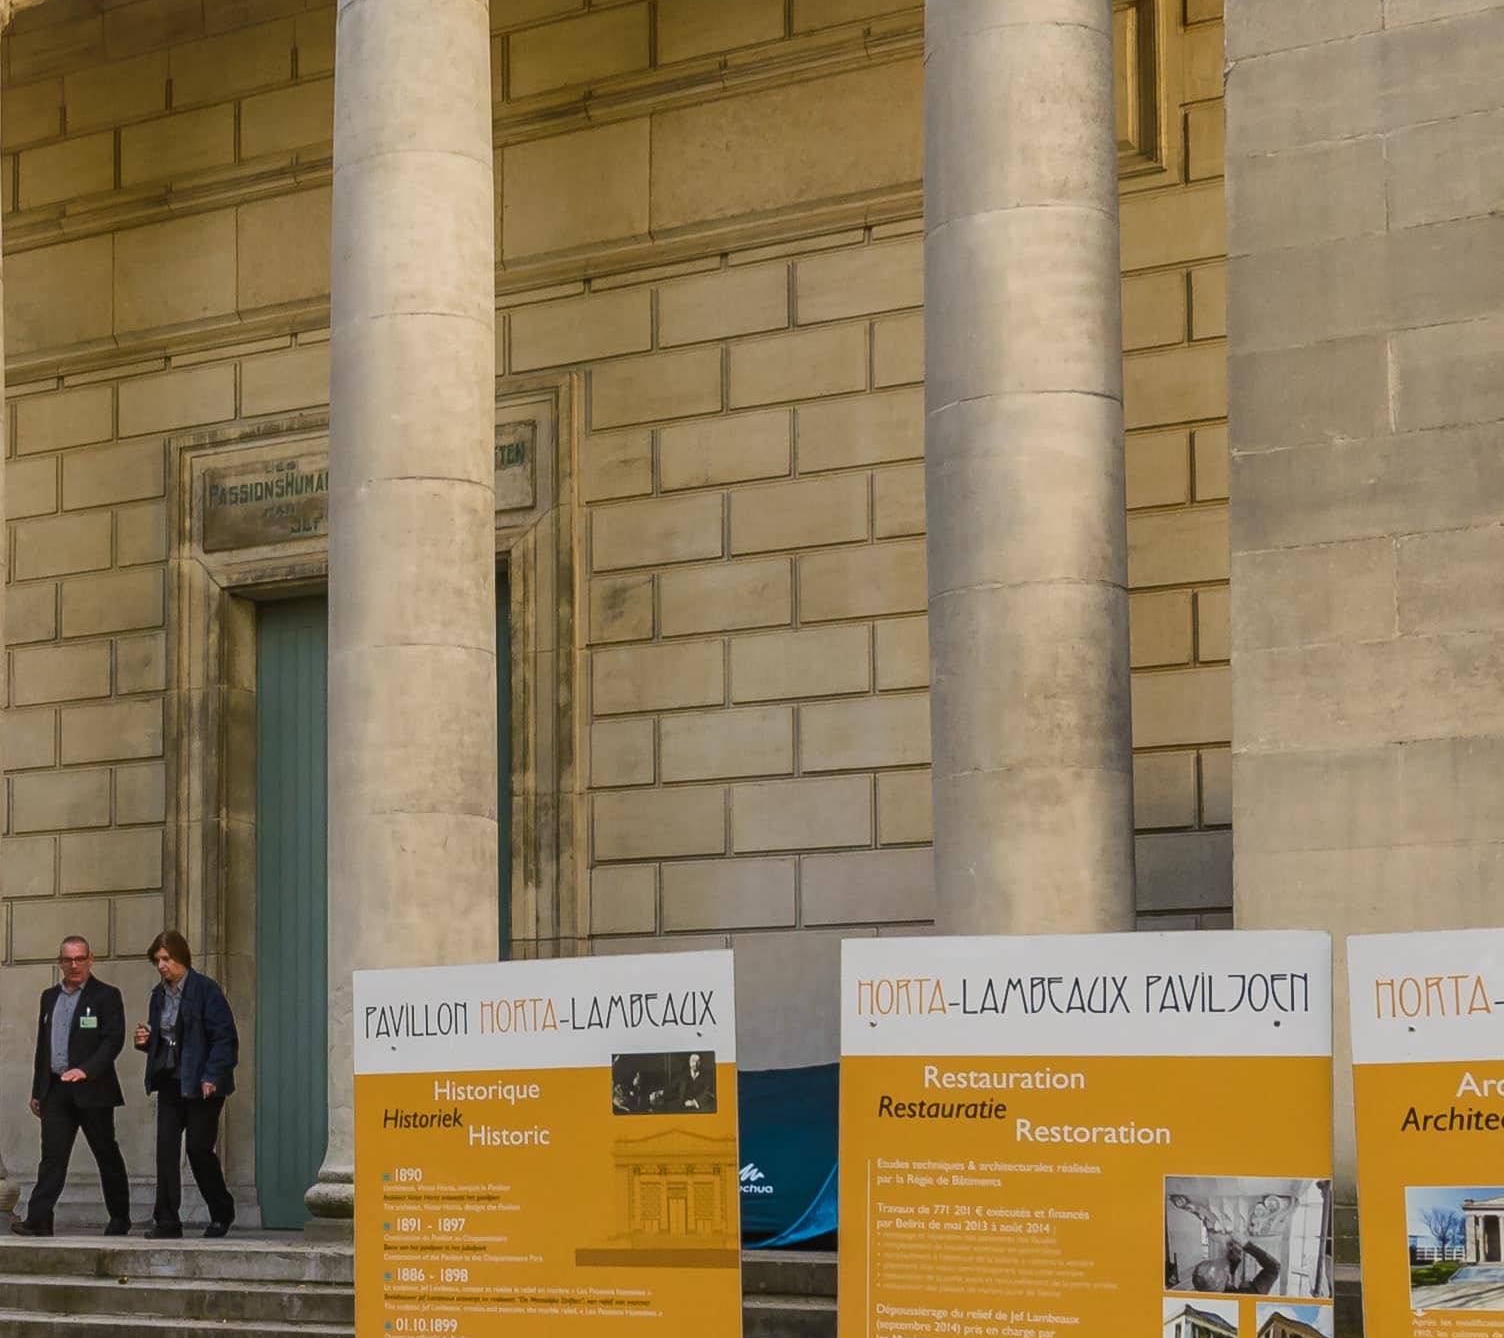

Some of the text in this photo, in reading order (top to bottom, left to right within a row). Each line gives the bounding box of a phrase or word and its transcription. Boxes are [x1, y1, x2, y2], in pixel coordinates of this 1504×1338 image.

[208, 479, 285, 507] PASSIONS
[857, 971, 1308, 1015] HORTA-LAMBEAUX PAVILJOEN
[364, 989, 717, 1039] PAVILLON HORTA-LAMBEAUX
[923, 1064, 1085, 1089] Restauration
[433, 1079, 540, 1106] Historique
[382, 1106, 463, 1129] Historiek
[877, 1094, 1007, 1119] Restauratie
[468, 1124, 550, 1146] Historic
[1015, 1117, 1171, 1145] Restoration
[394, 1167, 422, 1182] 1890
[396, 1217, 421, 1232] 1891
[437, 1216, 466, 1232] 1897
[396, 1267, 425, 1282] 1886
[439, 1267, 469, 1283] 1898
[395, 1317, 458, 1333] 01.10.1899
[875, 1318, 931, 1332] (septembre
[933, 1320, 961, 1334] 2014)
[962, 1324, 983, 1336] pris
[985, 1326, 999, 1335] en
